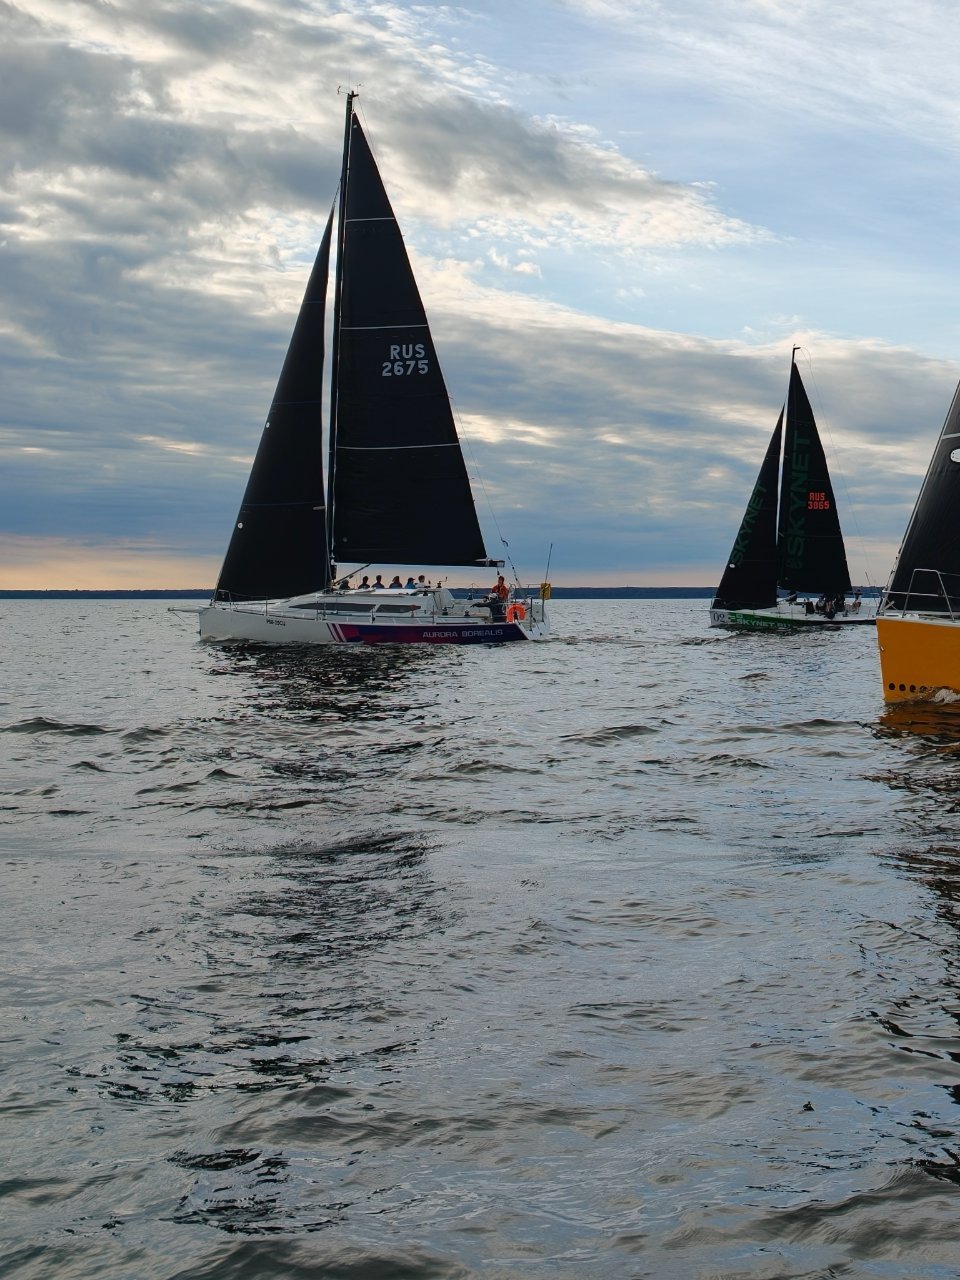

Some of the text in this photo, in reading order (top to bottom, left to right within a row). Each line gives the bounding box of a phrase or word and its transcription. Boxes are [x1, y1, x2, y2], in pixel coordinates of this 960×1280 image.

[390, 344, 426, 360] RUS
[381, 360, 429, 377] 2675
[787, 429, 811, 556] SKYNET
[809, 492, 825, 501] RUS
[732, 480, 767, 566] SKYNET
[461, 629, 504, 638] BOREALIS
